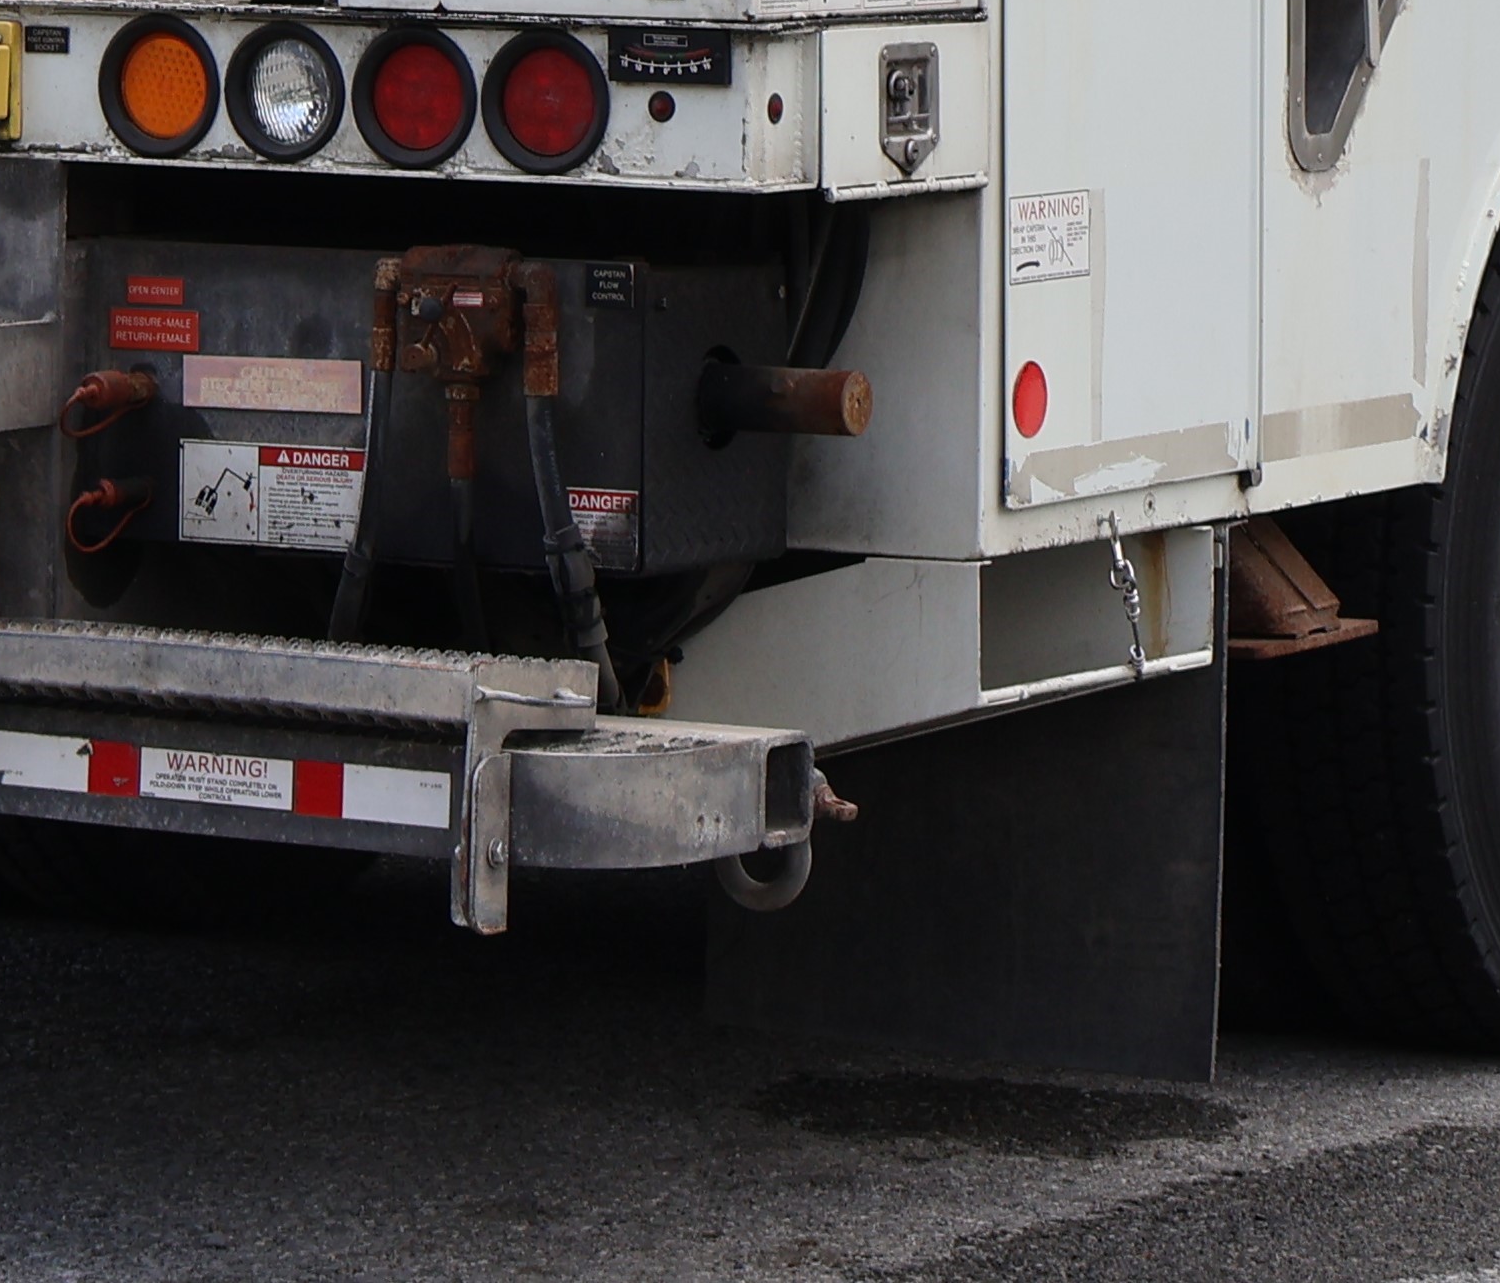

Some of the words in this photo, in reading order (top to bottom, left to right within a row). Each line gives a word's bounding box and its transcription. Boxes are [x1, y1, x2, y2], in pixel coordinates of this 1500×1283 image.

[33, 28, 62, 36] CAPSTAN
[1018, 196, 1084, 221] WARNING!
[593, 269, 626, 278] CAPSTAN
[128, 285, 150, 295] OPEN
[151, 286, 180, 296] CENTER
[599, 281, 619, 289] FLOW
[592, 292, 625, 301] CONTROL
[115, 316, 191, 329] PRESSURE-MALE
[115, 331, 191, 344] RETURN-FEMALE
[293, 452, 350, 468] DANGER
[282, 468, 324, 476] OVERTURNING
[569, 493, 632, 511] DANGER
[167, 752, 268, 779] WARNING!
[156, 773, 186, 782] OPERATOR
[207, 778, 227, 786] STAND
[229, 780, 266, 789] COMPLETELY
[204, 785, 224, 793] WHILE
[225, 787, 259, 798] OPERATING
[261, 791, 282, 799] LOWER
